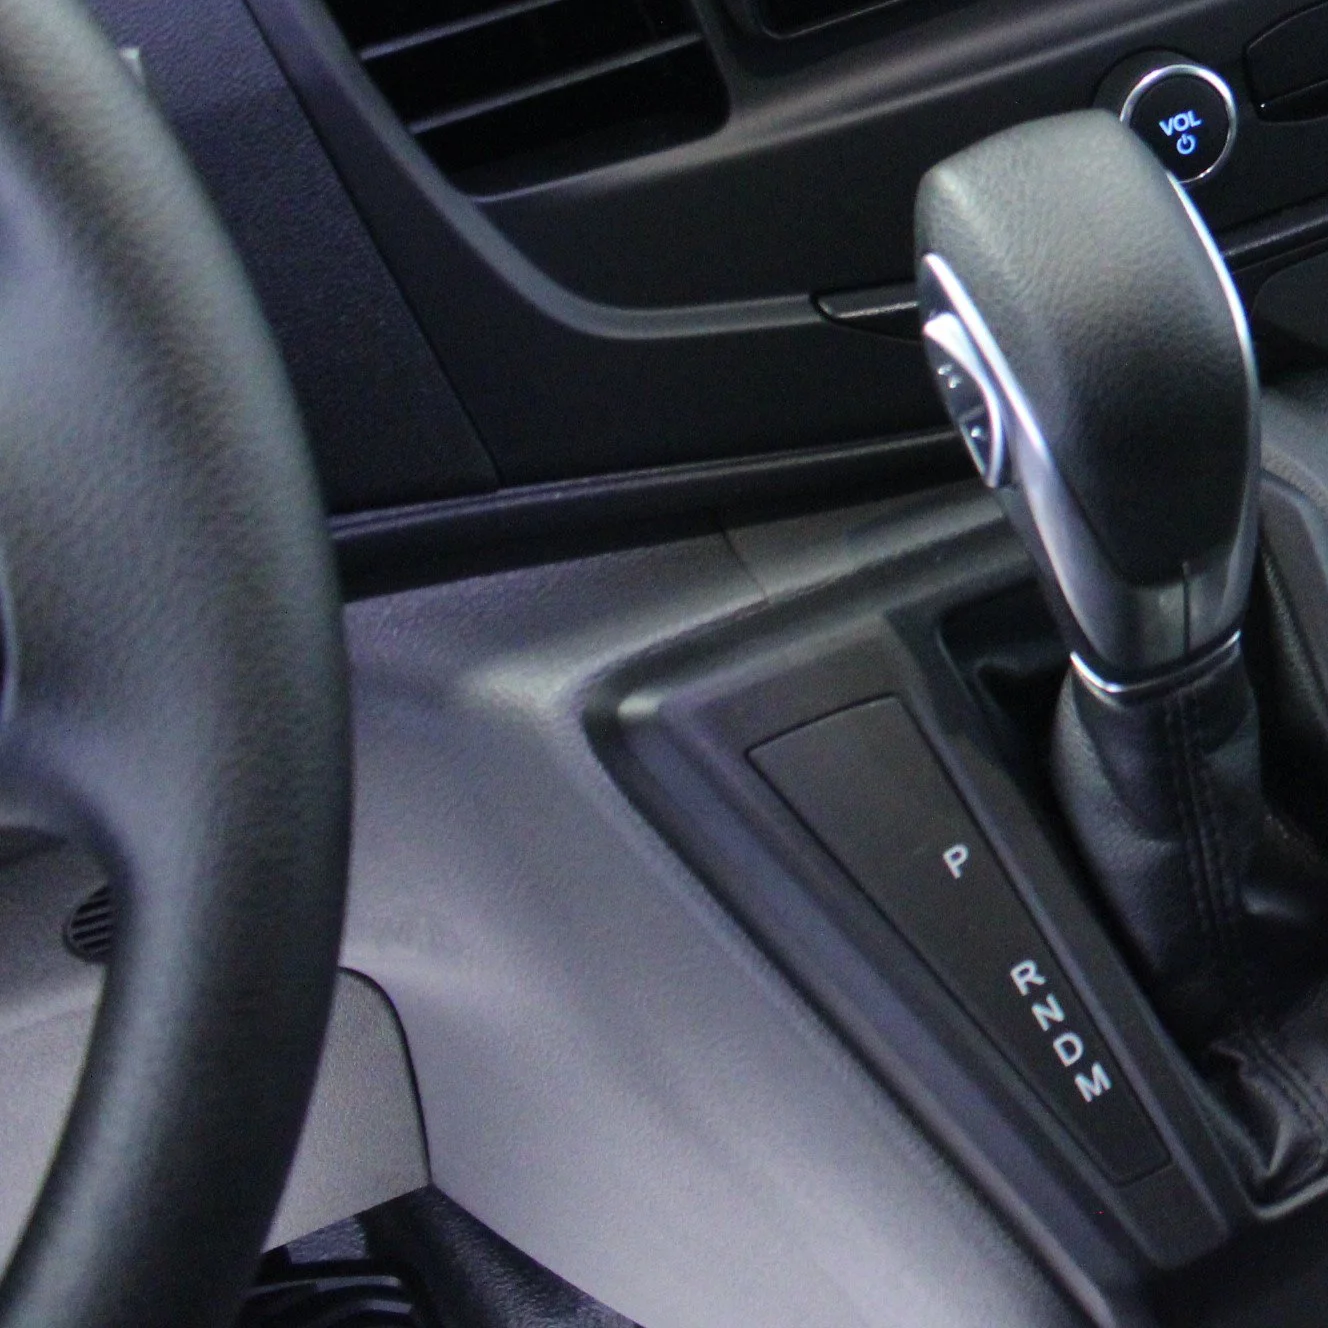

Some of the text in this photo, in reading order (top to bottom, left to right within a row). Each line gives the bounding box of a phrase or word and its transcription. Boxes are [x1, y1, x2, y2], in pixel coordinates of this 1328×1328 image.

[1159, 110, 1202, 137] VOL
[942, 845, 968, 878] P
[1010, 960, 1046, 996] R
[1032, 995, 1064, 1031] N
[1053, 1033, 1084, 1066] D
[1074, 1063, 1111, 1102] M
